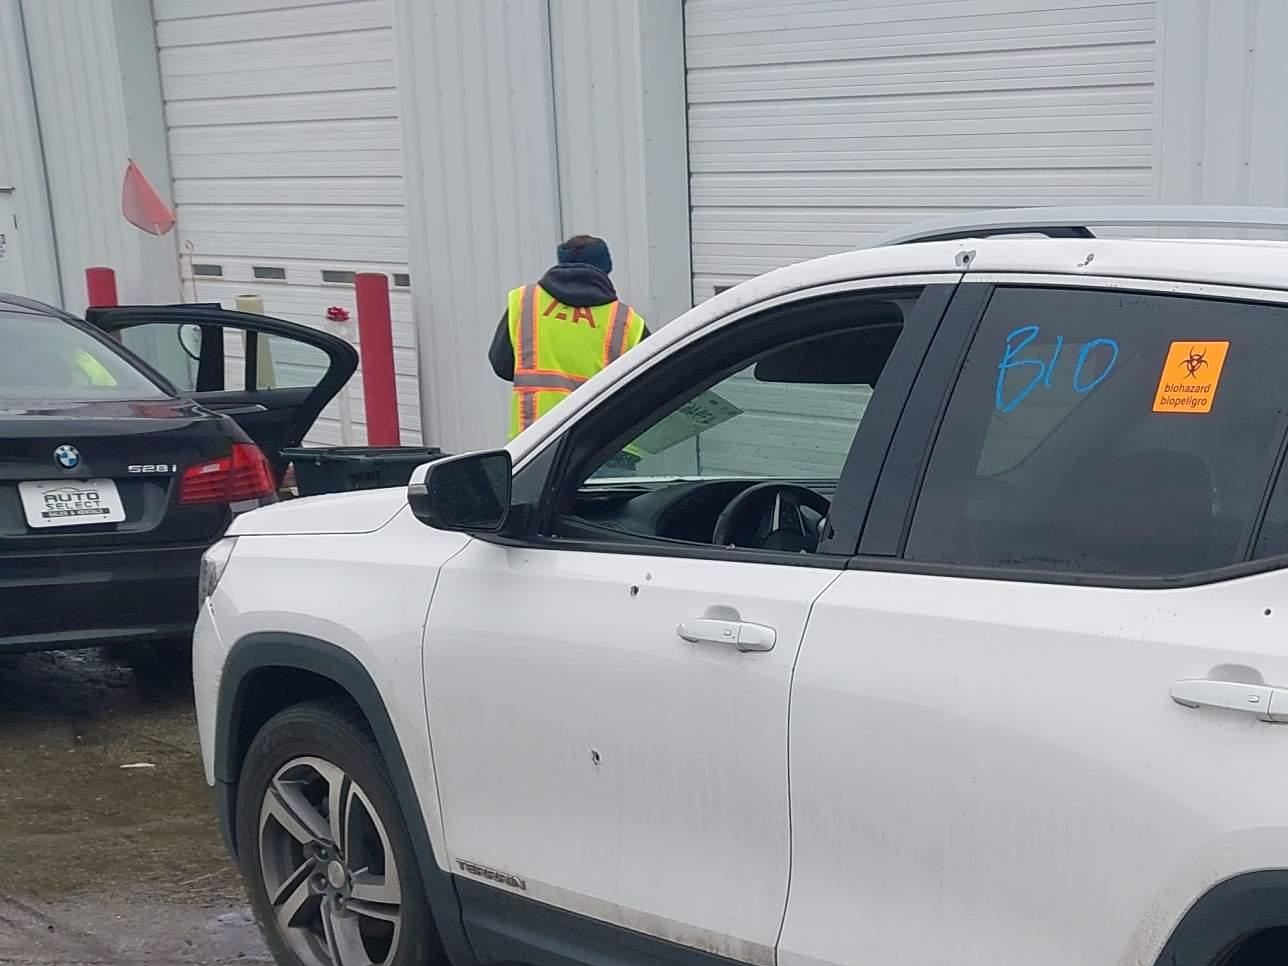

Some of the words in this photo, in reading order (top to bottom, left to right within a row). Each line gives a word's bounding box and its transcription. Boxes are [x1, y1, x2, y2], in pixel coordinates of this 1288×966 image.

[995, 324, 1119, 413] BIO
[1164, 383, 1211, 393] biohazard
[1160, 395, 1208, 408] biopeligro
[43, 492, 100, 503] AUTO
[46, 500, 101, 510] SELECT
